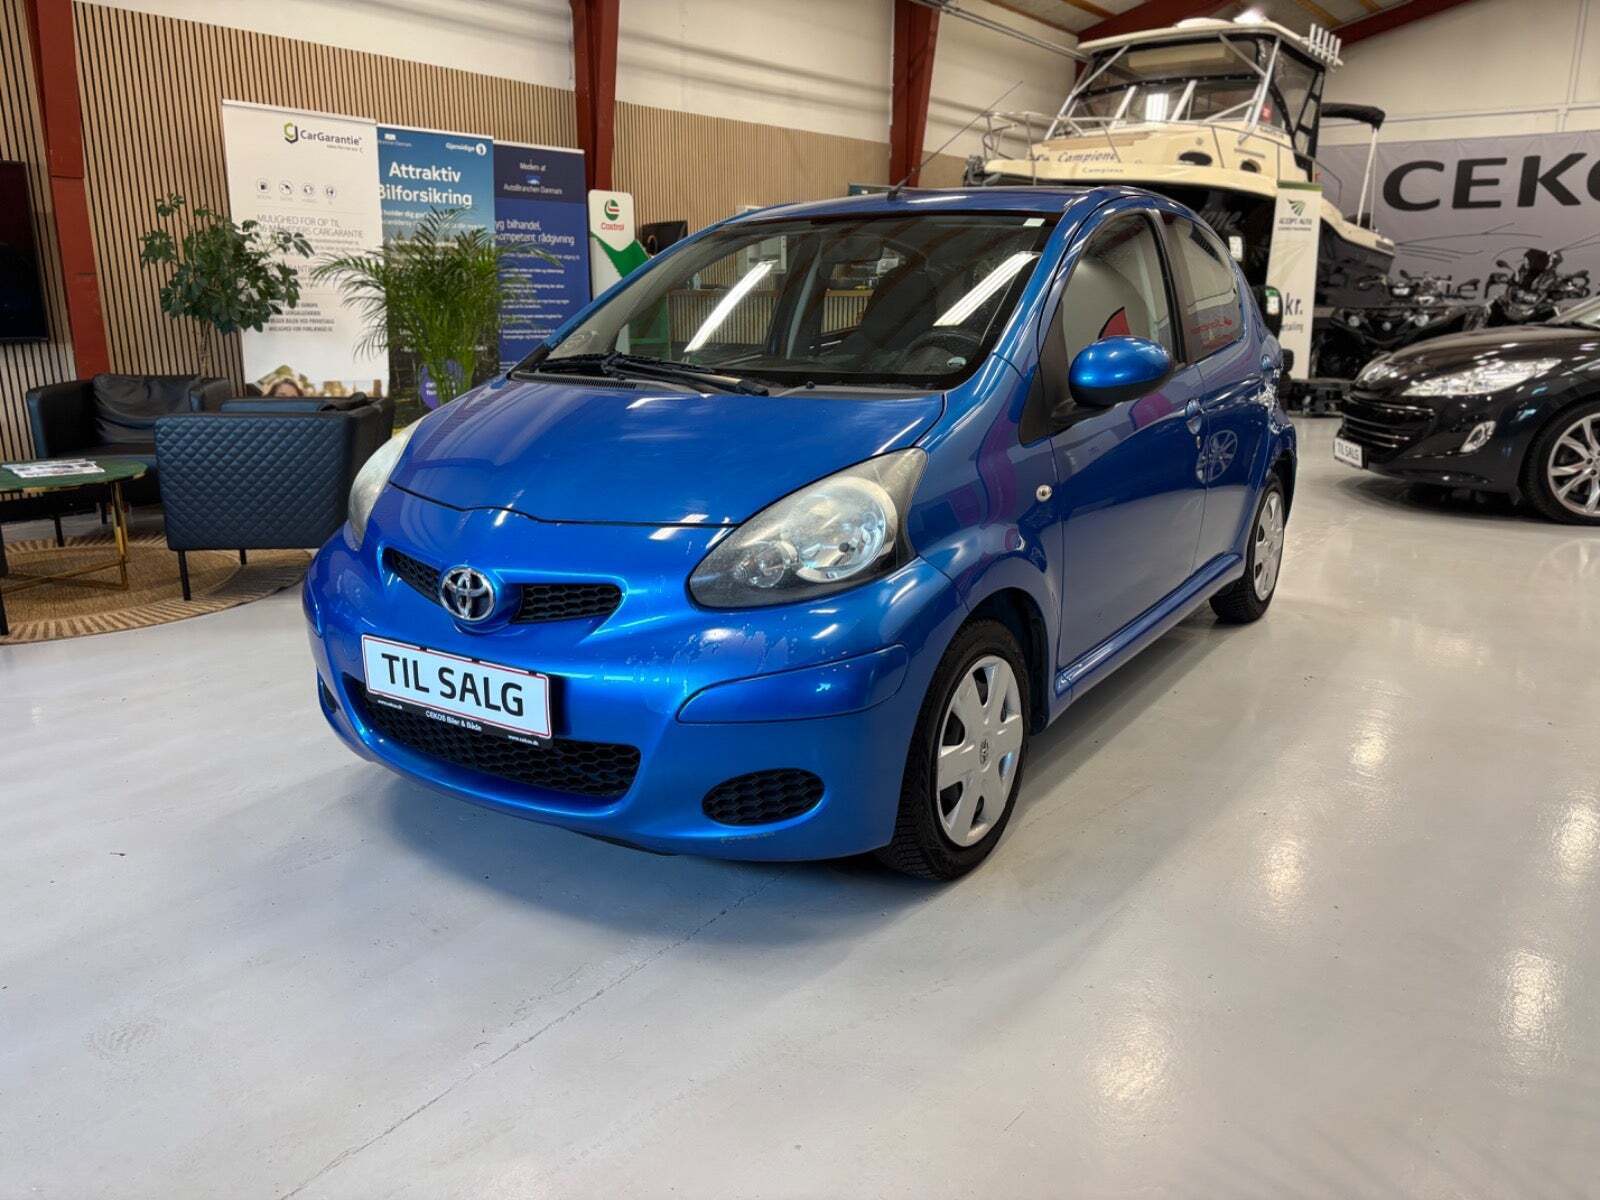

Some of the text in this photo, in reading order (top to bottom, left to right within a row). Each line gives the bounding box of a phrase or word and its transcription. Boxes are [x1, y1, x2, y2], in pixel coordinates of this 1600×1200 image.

[300, 129, 362, 146] CarGarantie
[389, 161, 461, 182] Attraktiv
[1382, 151, 1600, 211] CEK
[379, 184, 473, 210] Bilforsikring
[300, 217, 317, 226] FOR
[506, 219, 542, 231] bilhandel,
[601, 222, 625, 231] Castrol
[538, 232, 576, 247] rådgivning
[1284, 292, 1304, 316] kr.
[381, 652, 525, 717] TIL SALG
